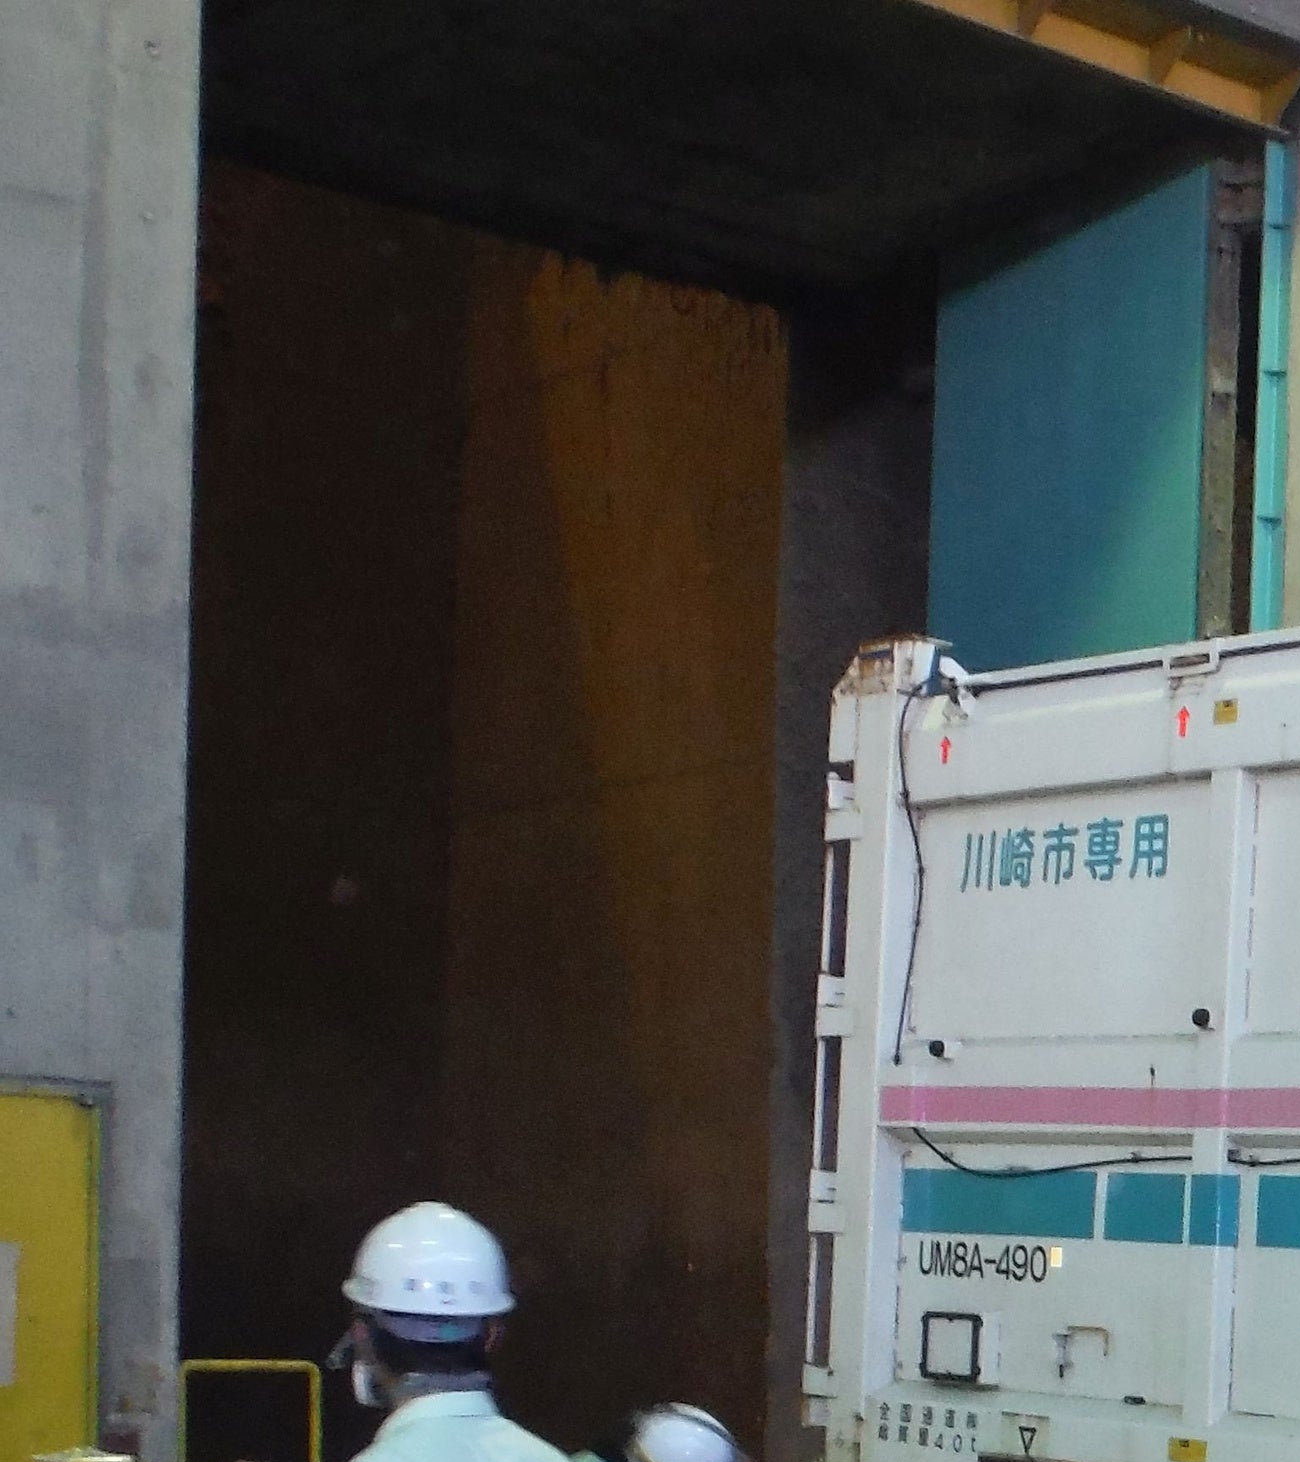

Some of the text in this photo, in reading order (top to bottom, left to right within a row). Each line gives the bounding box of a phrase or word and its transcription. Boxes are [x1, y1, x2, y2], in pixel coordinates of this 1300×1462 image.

[960, 813, 1169, 893] 川崎市専用
[919, 1240, 1048, 1283] UM8A-490
